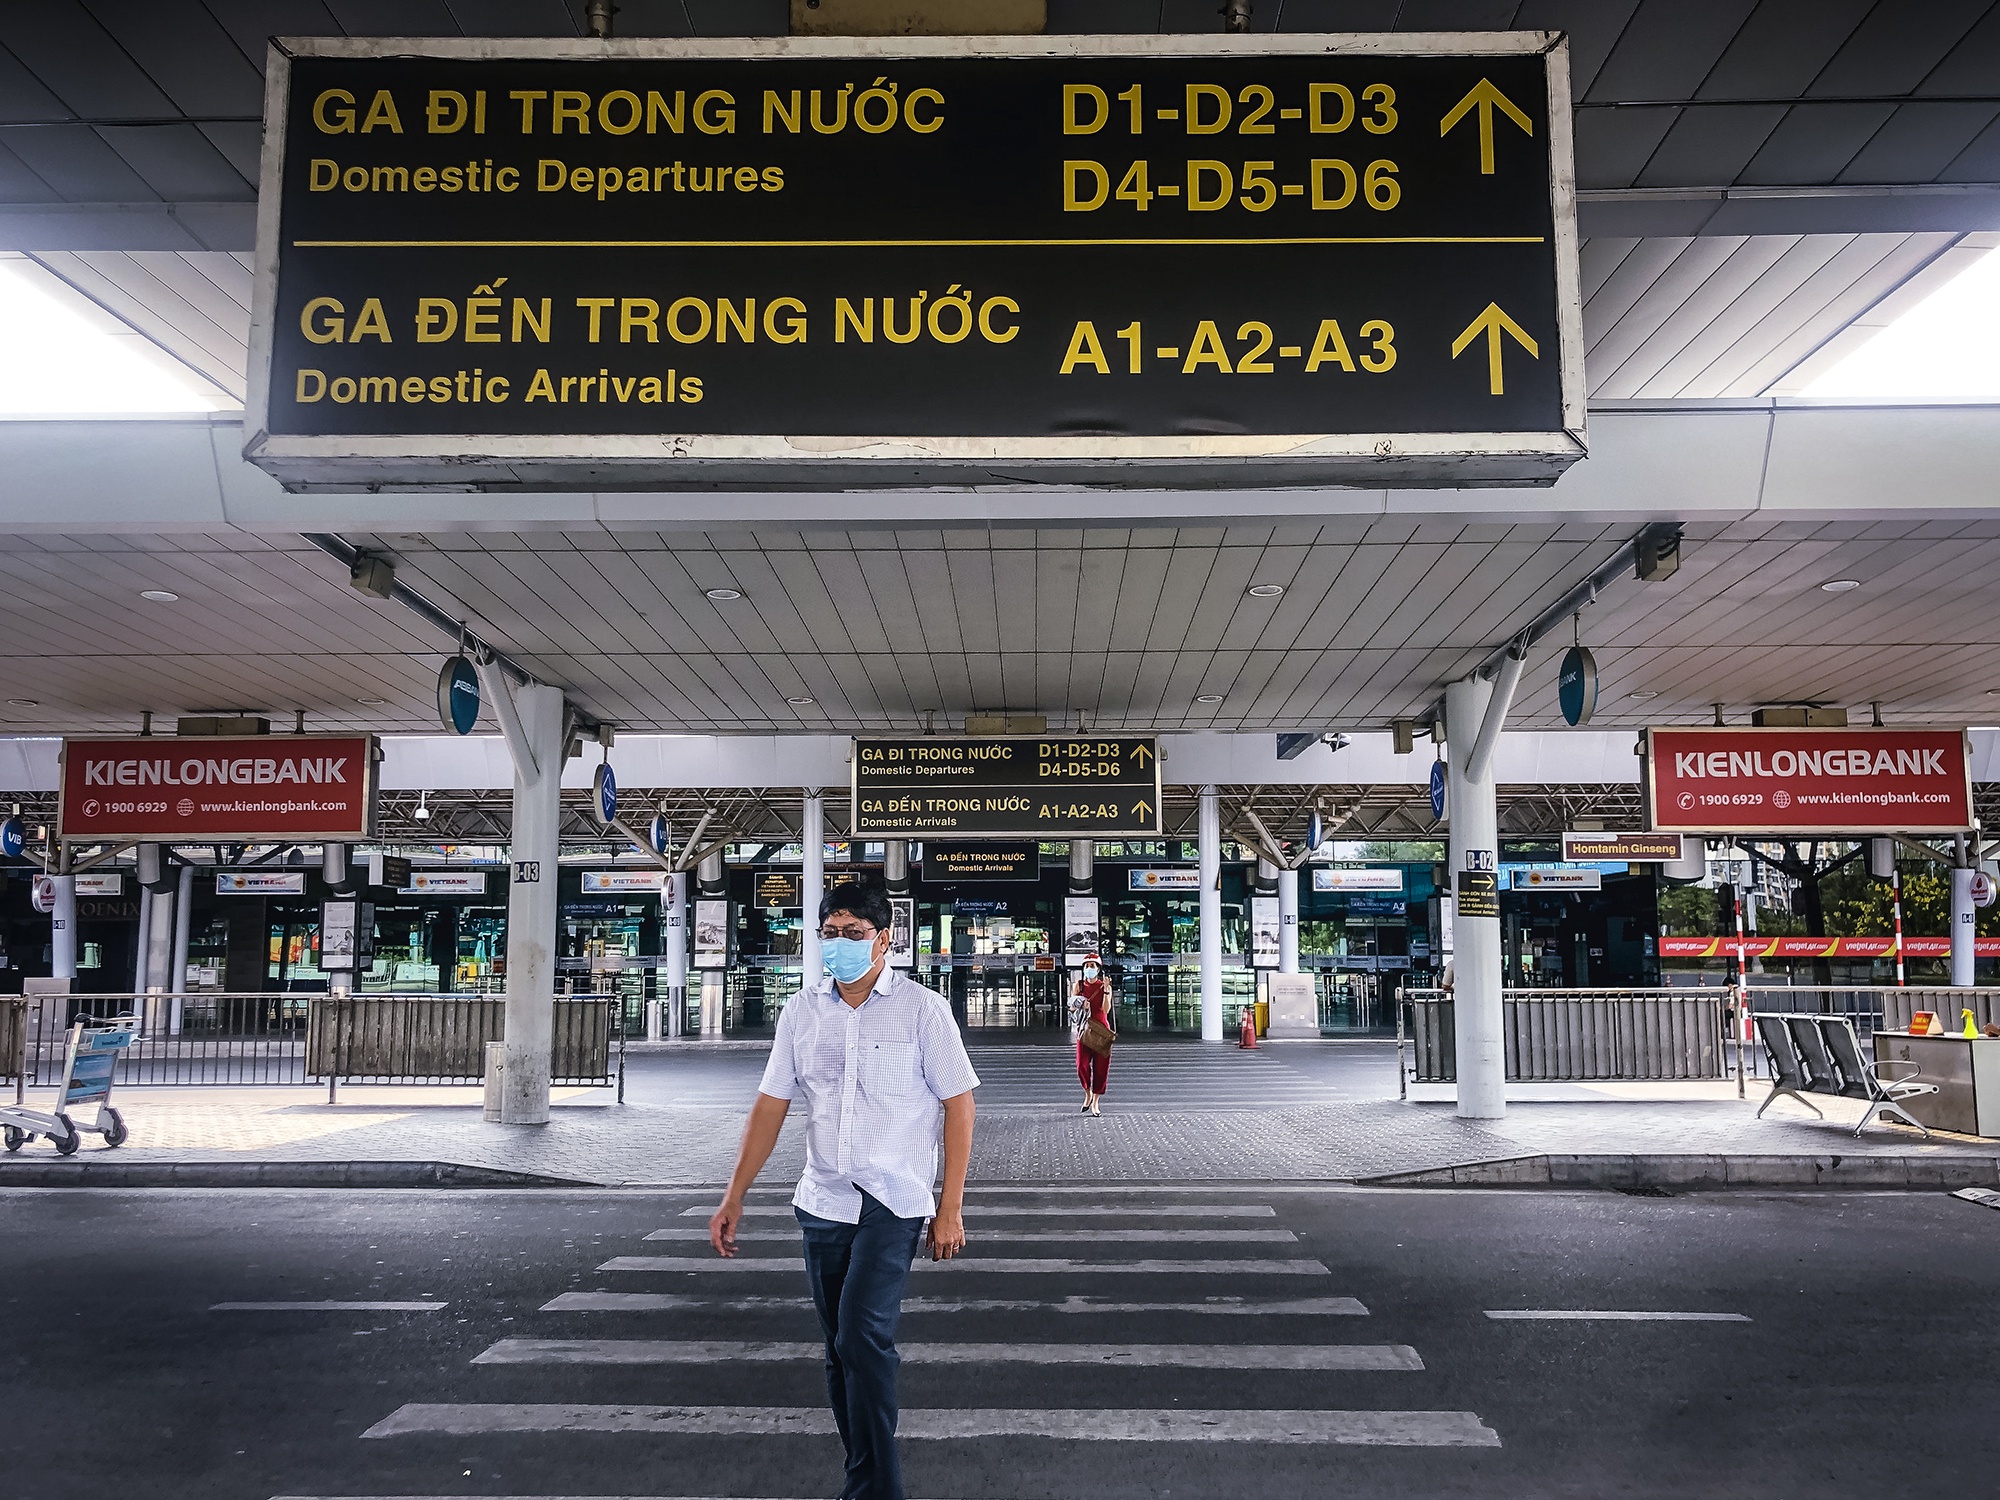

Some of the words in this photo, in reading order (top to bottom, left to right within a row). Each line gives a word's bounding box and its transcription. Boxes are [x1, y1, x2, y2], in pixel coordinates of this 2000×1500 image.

[312, 88, 404, 135] GA
[425, 90, 487, 134] ĐI
[509, 89, 736, 135] TRONG
[762, 77, 946, 135] NƯỚC
[1062, 82, 1399, 135] D1-D2-D3
[309, 158, 520, 193] Domestic
[537, 159, 786, 201] Departures
[1063, 158, 1402, 213] D4-D5-D6
[300, 296, 393, 345] GA
[415, 277, 552, 344] ĐẾN
[576, 296, 808, 345] TRONG
[834, 283, 1021, 345] NƯỚC
[1058, 319, 1398, 375] A1-A2-A3
[295, 368, 510, 404] Domestic
[524, 368, 704, 404] Arrivals
[861, 748, 883, 761] GA
[888, 748, 904, 760] ĐI
[908, 747, 964, 761] TRONG
[968, 743, 1012, 760] NƯỚC
[1038, 743, 1121, 758] D1-D2-D3
[861, 765, 912, 775] Domestic
[915, 764, 975, 777] Departures
[1038, 762, 1121, 777] D4-D5-D6
[1675, 748, 1947, 778] KIENLONGBANK
[85, 757, 347, 786] KIENLONGBANK
[861, 799, 883, 813] GA
[888, 794, 921, 812] ĐẾN
[926, 798, 981, 812] TRONG
[986, 795, 1031, 812] NƯỚC
[1699, 794, 1730, 806] 1900
[1732, 793, 1764, 806] 6929
[1797, 791, 1951, 806] www.kienlongbank.com
[104, 801, 135, 814] 1900
[136, 801, 168, 814] 6929
[200, 799, 347, 814] www.kienlongbank.com
[1038, 803, 1119, 819] A1-A2-A3
[861, 816, 912, 827] Domestic
[915, 816, 957, 827] Arrivals
[8, 831, 22, 845] VIB
[936, 853, 949, 862] GA
[950, 850, 969, 861] ĐẾN
[970, 852, 1000, 861] TRONG
[1001, 851, 1026, 861] NƯỚC
[1572, 843, 1629, 855] Homtamin
[1630, 843, 1676, 856] Ginseng
[948, 864, 982, 872] Domestic
[984, 864, 1014, 872] Arrivals
[1467, 851, 1493, 870] B-02
[77, 902, 141, 917] OENIX
[605, 904, 617, 913] A1
[996, 901, 1008, 910] A2
[1392, 902, 1405, 911] A3
